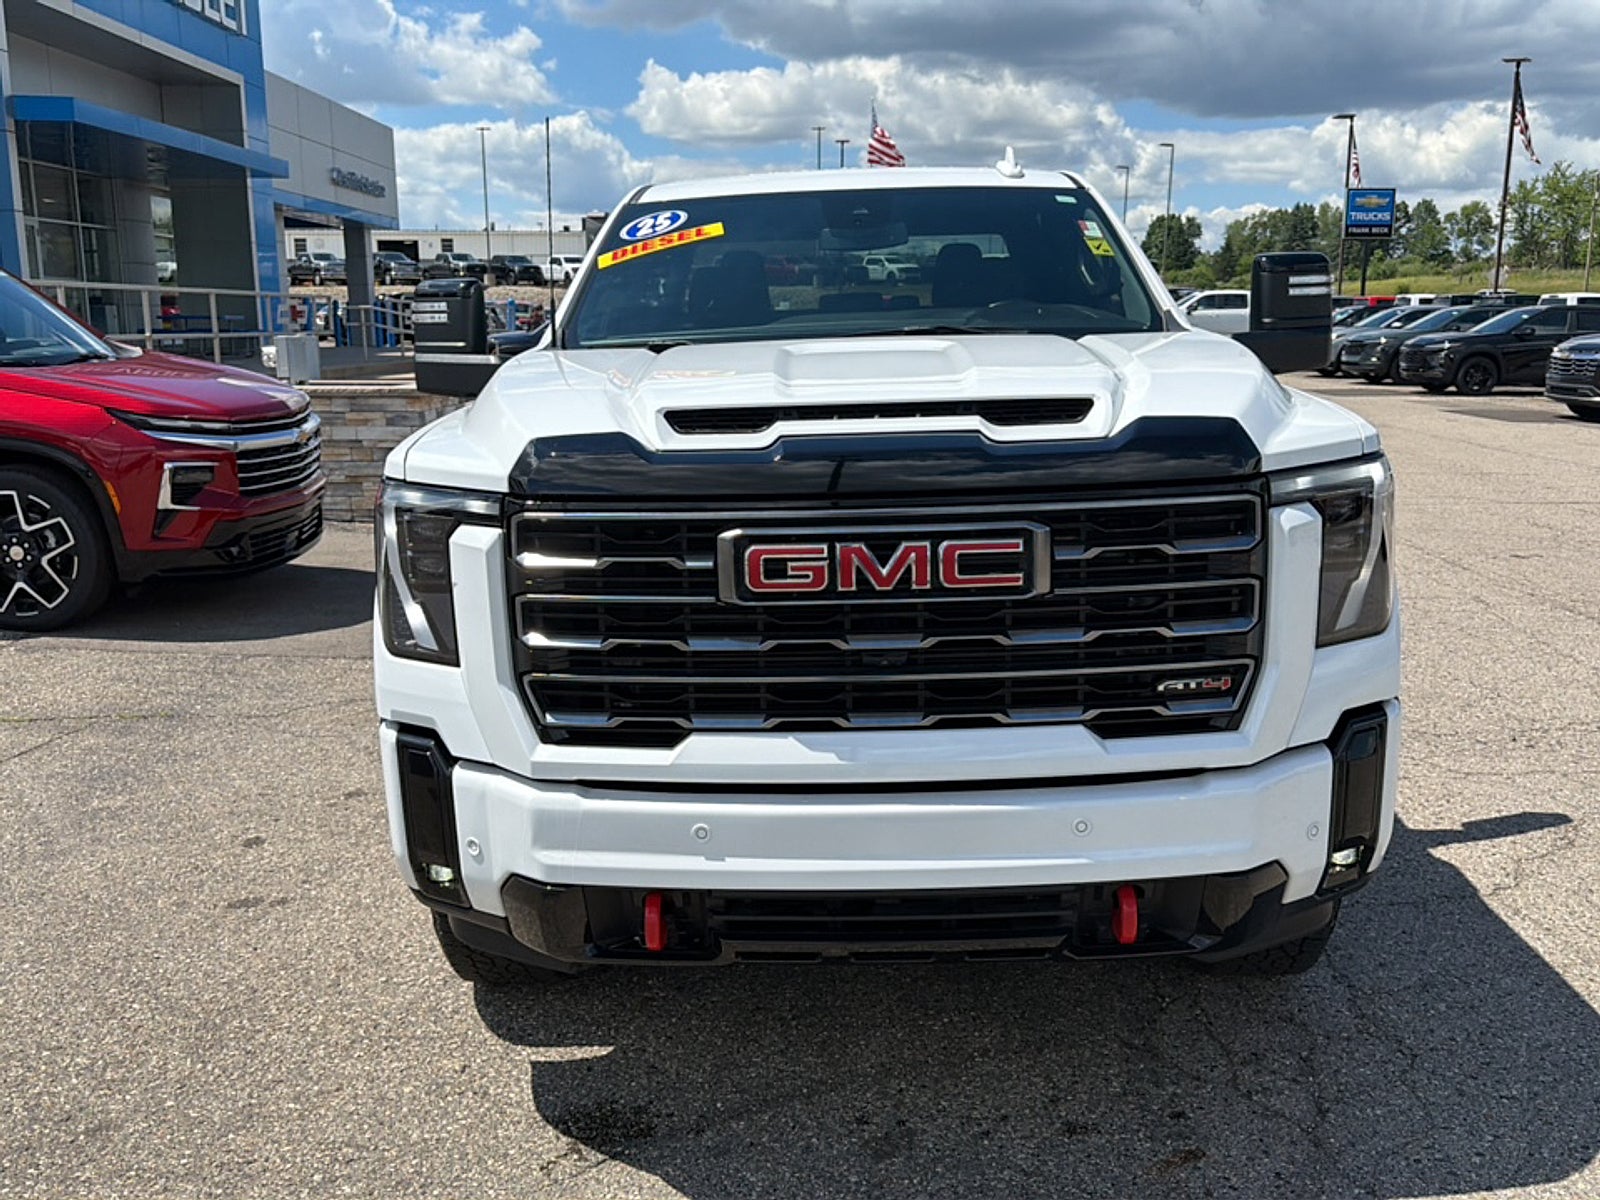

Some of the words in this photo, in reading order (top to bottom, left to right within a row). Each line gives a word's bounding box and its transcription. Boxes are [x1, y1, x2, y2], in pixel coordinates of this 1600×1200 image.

[635, 211, 673, 238] 25
[1350, 211, 1391, 221] TRUCKS
[611, 227, 712, 262] DIESEL
[745, 539, 1024, 593] GMC
[1157, 676, 1231, 692] AT4
